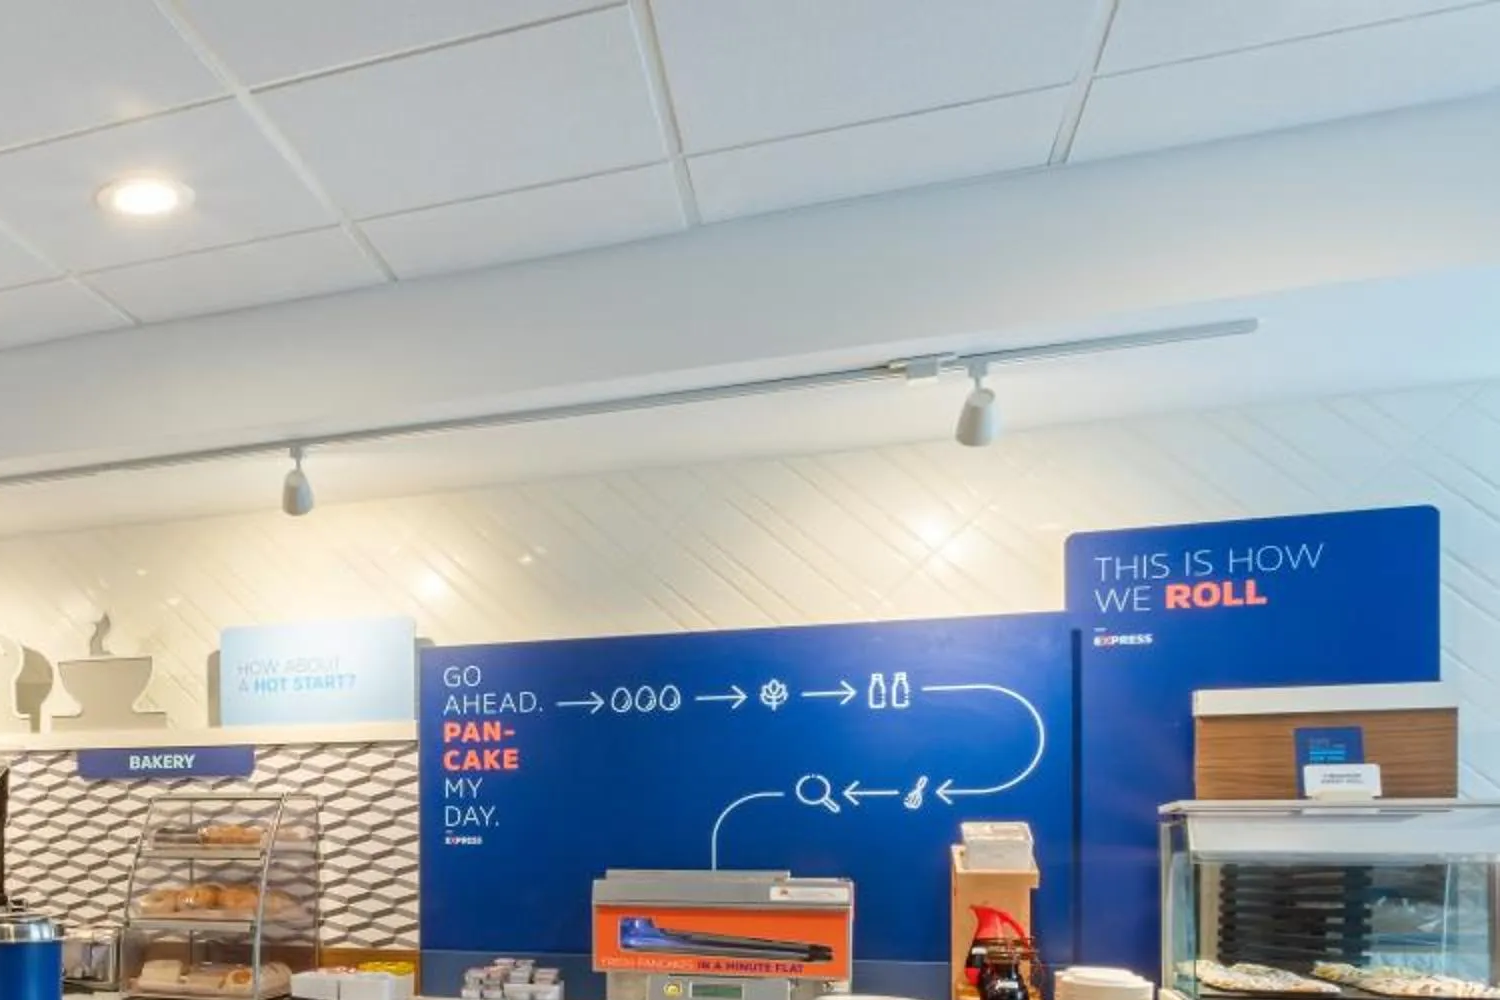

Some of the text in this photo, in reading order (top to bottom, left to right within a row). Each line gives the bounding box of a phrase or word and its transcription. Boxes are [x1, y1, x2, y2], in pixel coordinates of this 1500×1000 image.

[1094, 543, 1324, 582] THIS IS HOW
[1094, 579, 1268, 613] WE ROLL
[1094, 634, 1153, 647] EXPRESS
[237, 659, 280, 676] HOW
[443, 665, 482, 687] GO
[238, 673, 357, 693] A HOT START?
[443, 691, 543, 715] AHEAD.
[443, 721, 515, 743] PAN-
[129, 754, 196, 770] BAKERY
[443, 749, 520, 771] CAKE
[444, 776, 483, 799] MY
[444, 804, 500, 828] DAY.
[697, 960, 710, 969] IN
[725, 960, 772, 973] MINUTE
[775, 962, 804, 973] FLAT
